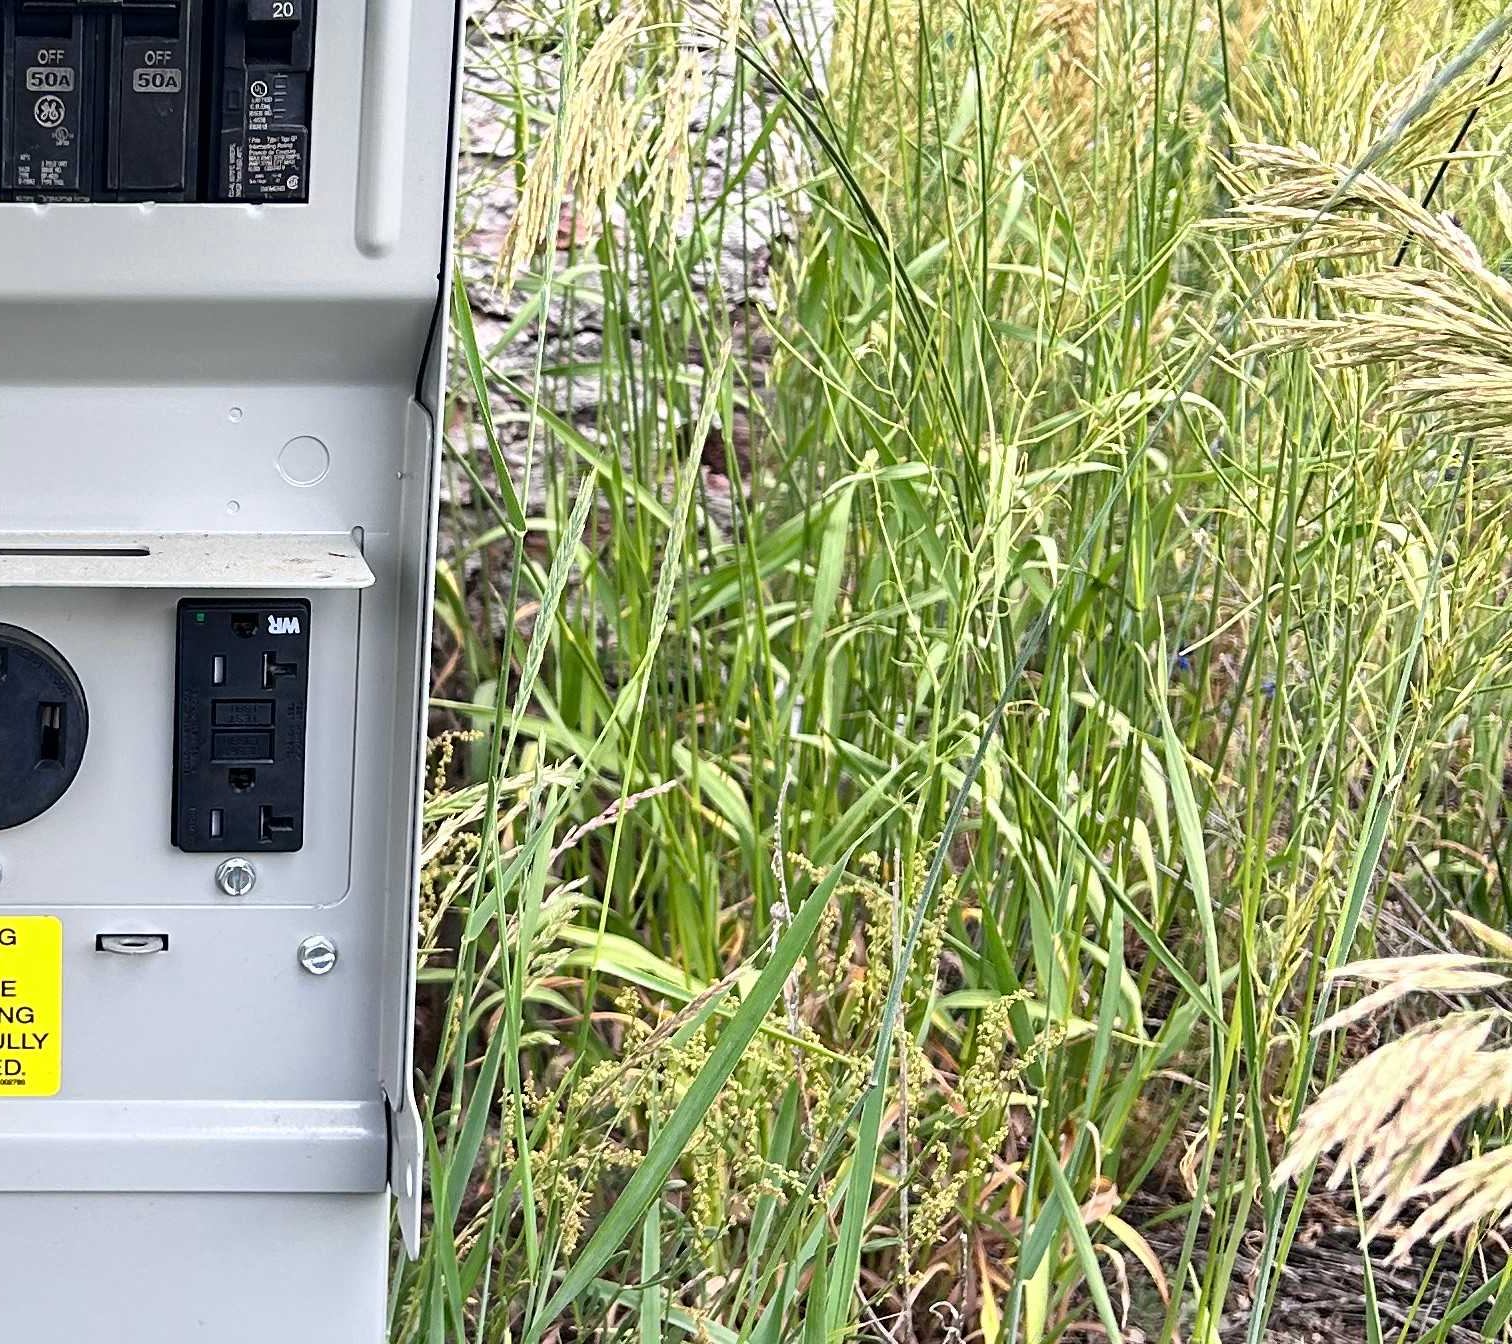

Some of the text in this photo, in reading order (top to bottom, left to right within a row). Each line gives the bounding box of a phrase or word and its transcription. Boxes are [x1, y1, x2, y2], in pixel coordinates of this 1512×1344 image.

[272, 2, 294, 18] 20
[38, 49, 65, 65] OFF
[144, 50, 172, 66] OFF
[31, 71, 71, 88] 50A
[138, 72, 178, 89] 50A
[267, 614, 301, 635] WR
